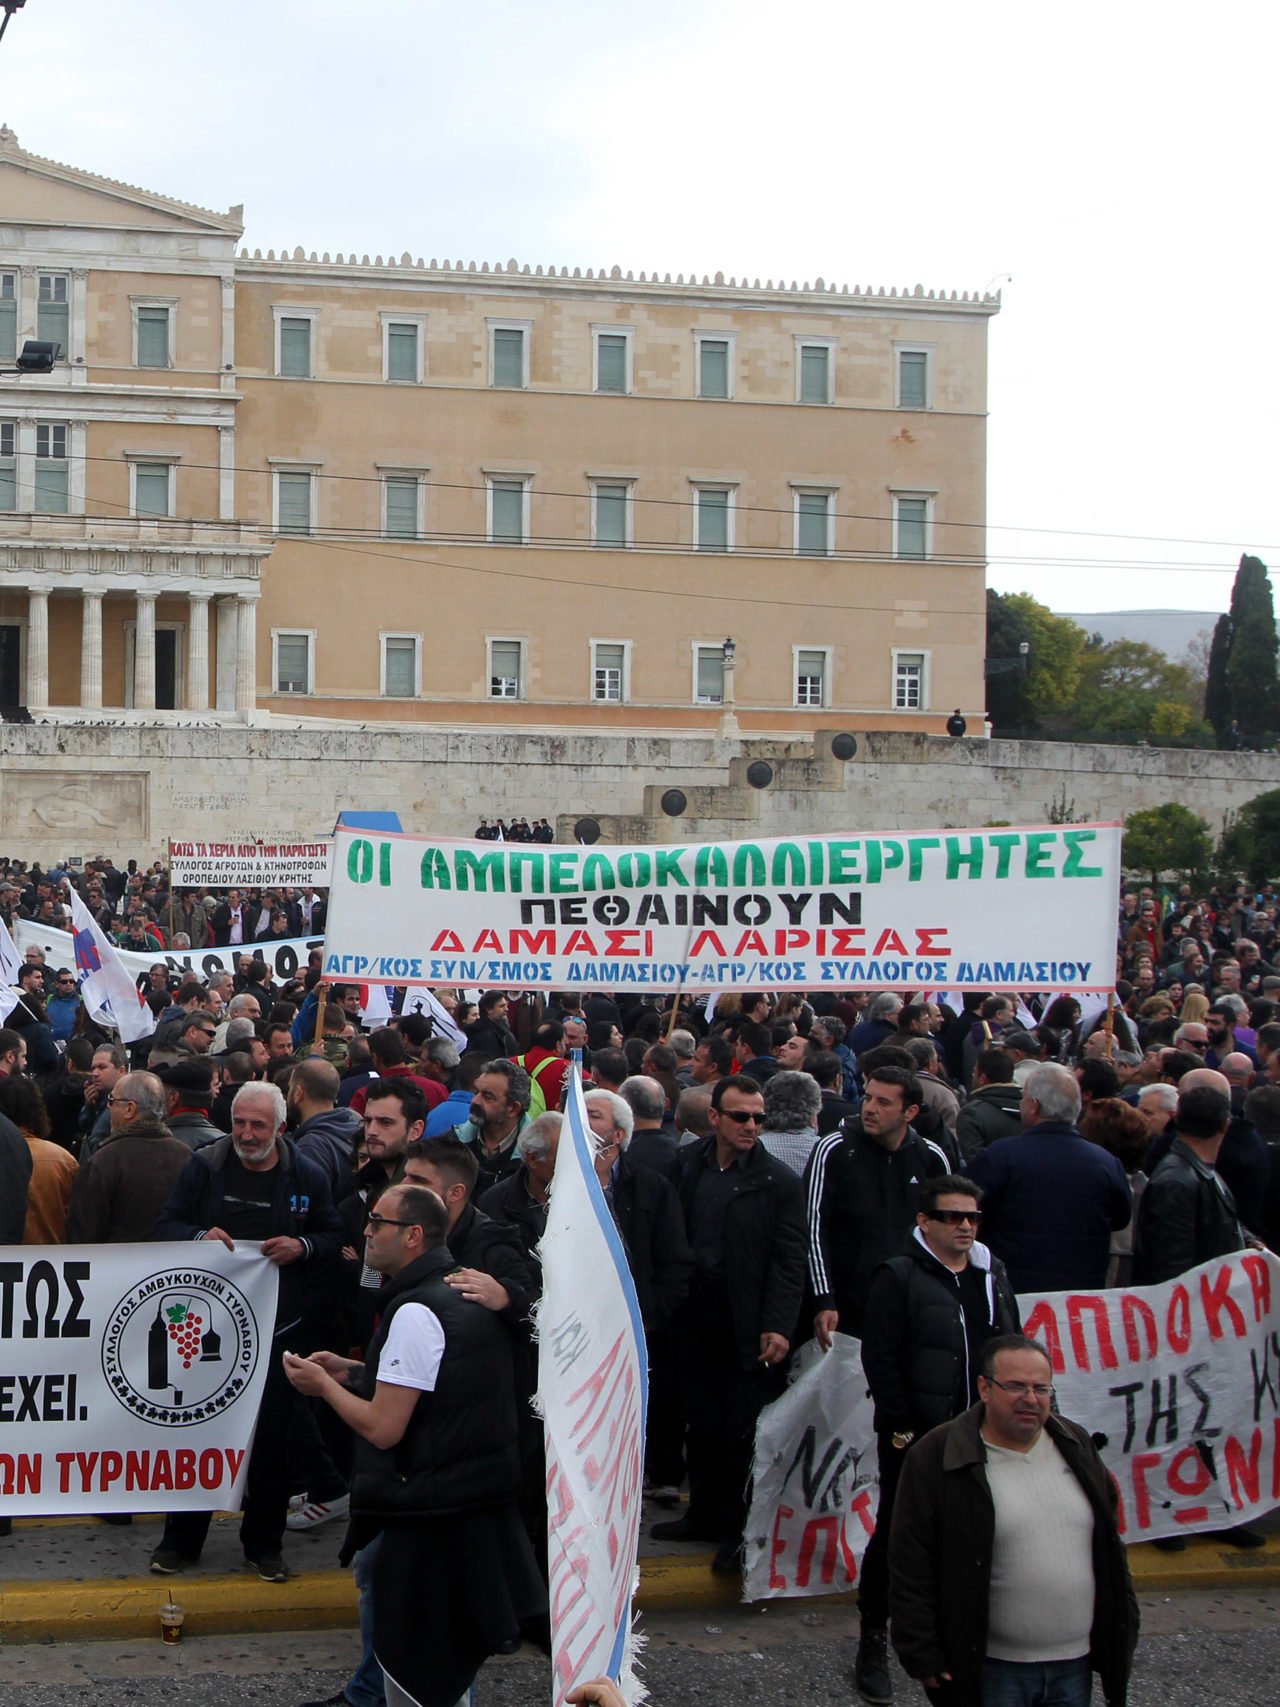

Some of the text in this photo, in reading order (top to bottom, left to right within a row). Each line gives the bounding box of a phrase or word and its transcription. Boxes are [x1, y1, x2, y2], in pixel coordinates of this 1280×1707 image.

[170, 842, 328, 858] ΚΑΤΩ ΤΑ ΧΕΡΙΑ ΑΠΟ ΤΗΝ ΠΑΡΑΓΩΓΗ
[170, 860, 328, 871] ΣΥΛΛΟΓΟΣ ΑΓΡΟΤΩΝ & ΚΤΗΝΟΤΡΟΦΩΝ
[347, 830, 1104, 894] ΟΙ ΑΜΠΕΛΟΚΑΛΛΙΕΡΓΗΤΕΣ
[182, 873, 313, 884] ΟΡΟΠΕΔΙΟΥ ΛΑΣΙΘΙΟΥ ΚΡΗΤΗΣ
[520, 891, 862, 926] ΠΕΘΑΙΝΟΥΝ
[429, 928, 952, 957] ΔΑΜΑΣΙ ΛΑΡΙΣΑΣ
[326, 953, 423, 978] ΑΓΡ/ΚΟΣ
[430, 959, 553, 982] ΣΥΝ/ΣΜΟΣ
[820, 960, 947, 982] ΣΥΛΛΟΓΟΣ
[955, 961, 1092, 983] ΔΑΜΑΣΙΟΥ
[105, 1273, 252, 1375] ΣΥΛΛΟΓΟΣ ΑΜΒΥΚΟΥΧΩΝ ΤΥΡΝΑΒΟΥ
[1109, 1362, 1223, 1454] ΤΗΣ
[55, 1448, 245, 1494] ΤΥΡΝΑΒΟΥ
